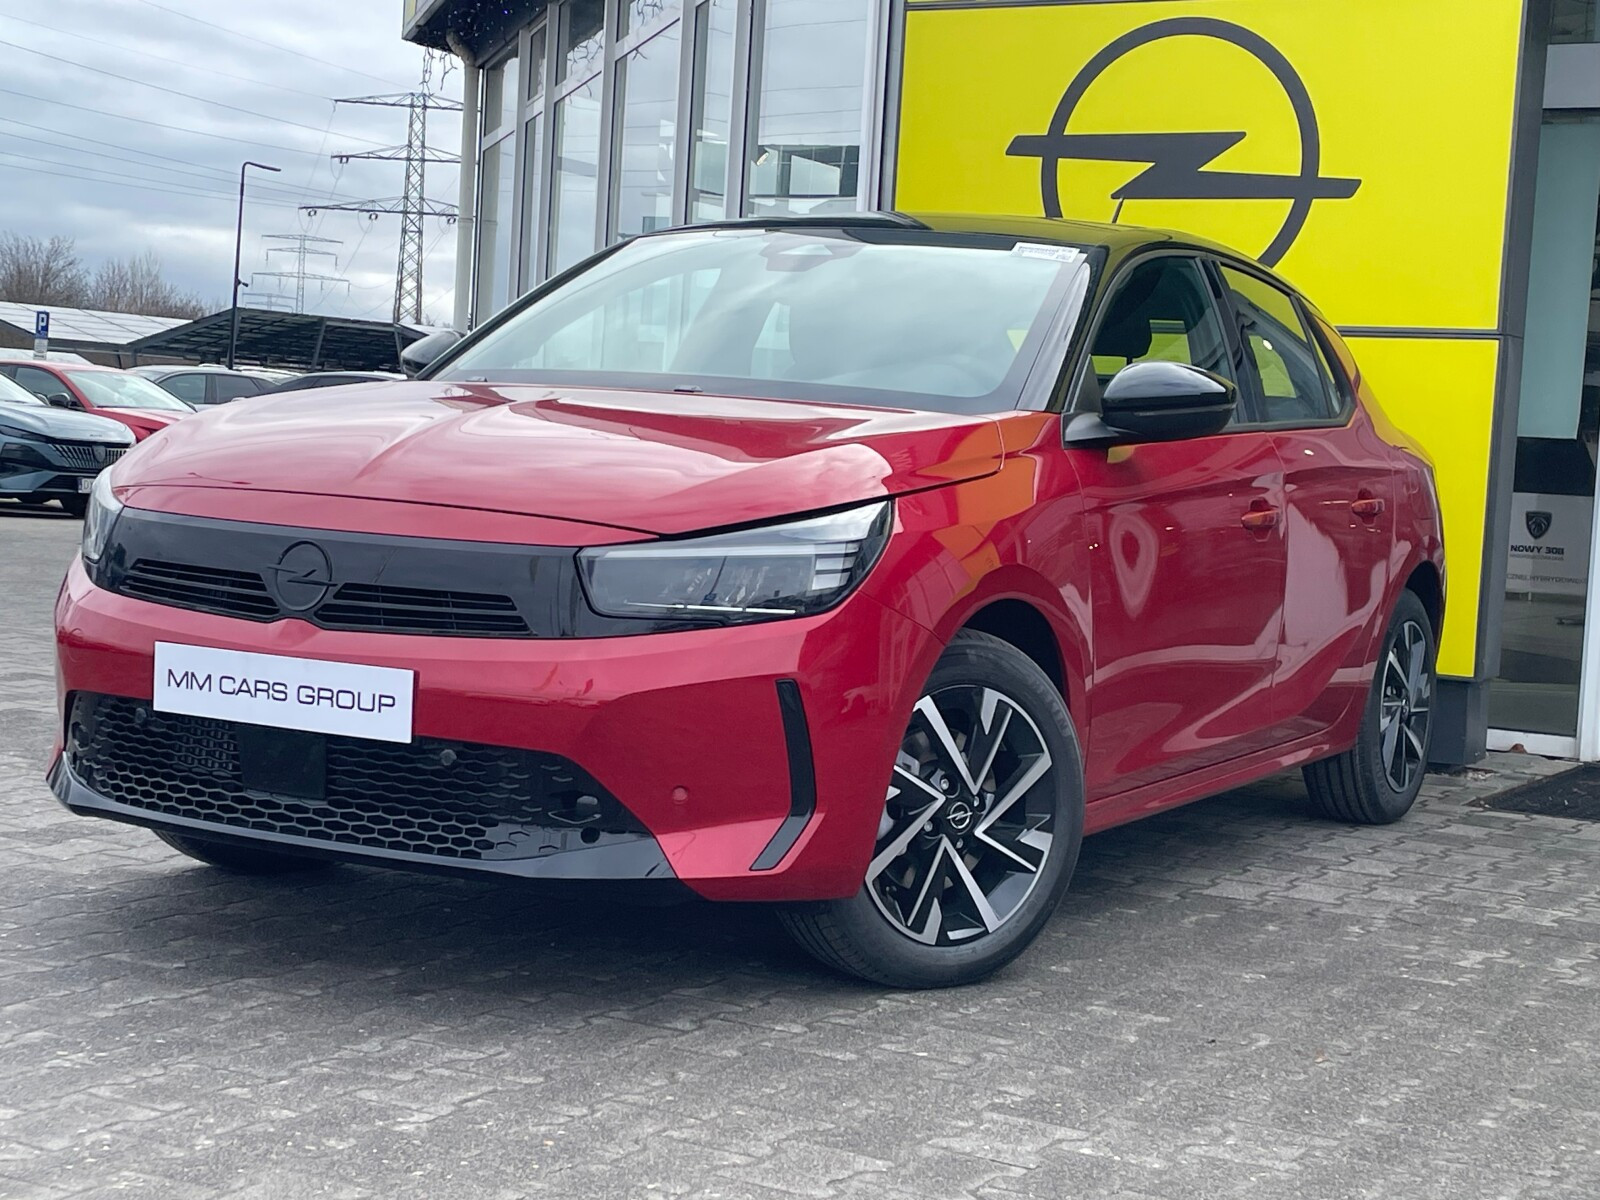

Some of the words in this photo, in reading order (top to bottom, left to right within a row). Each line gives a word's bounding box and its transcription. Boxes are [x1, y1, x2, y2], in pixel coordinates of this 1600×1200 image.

[38, 313, 47, 331] P
[1510, 544, 1543, 554] NOWY
[167, 668, 212, 692] MM
[219, 675, 288, 702] CARS
[297, 685, 396, 713] GROUP
